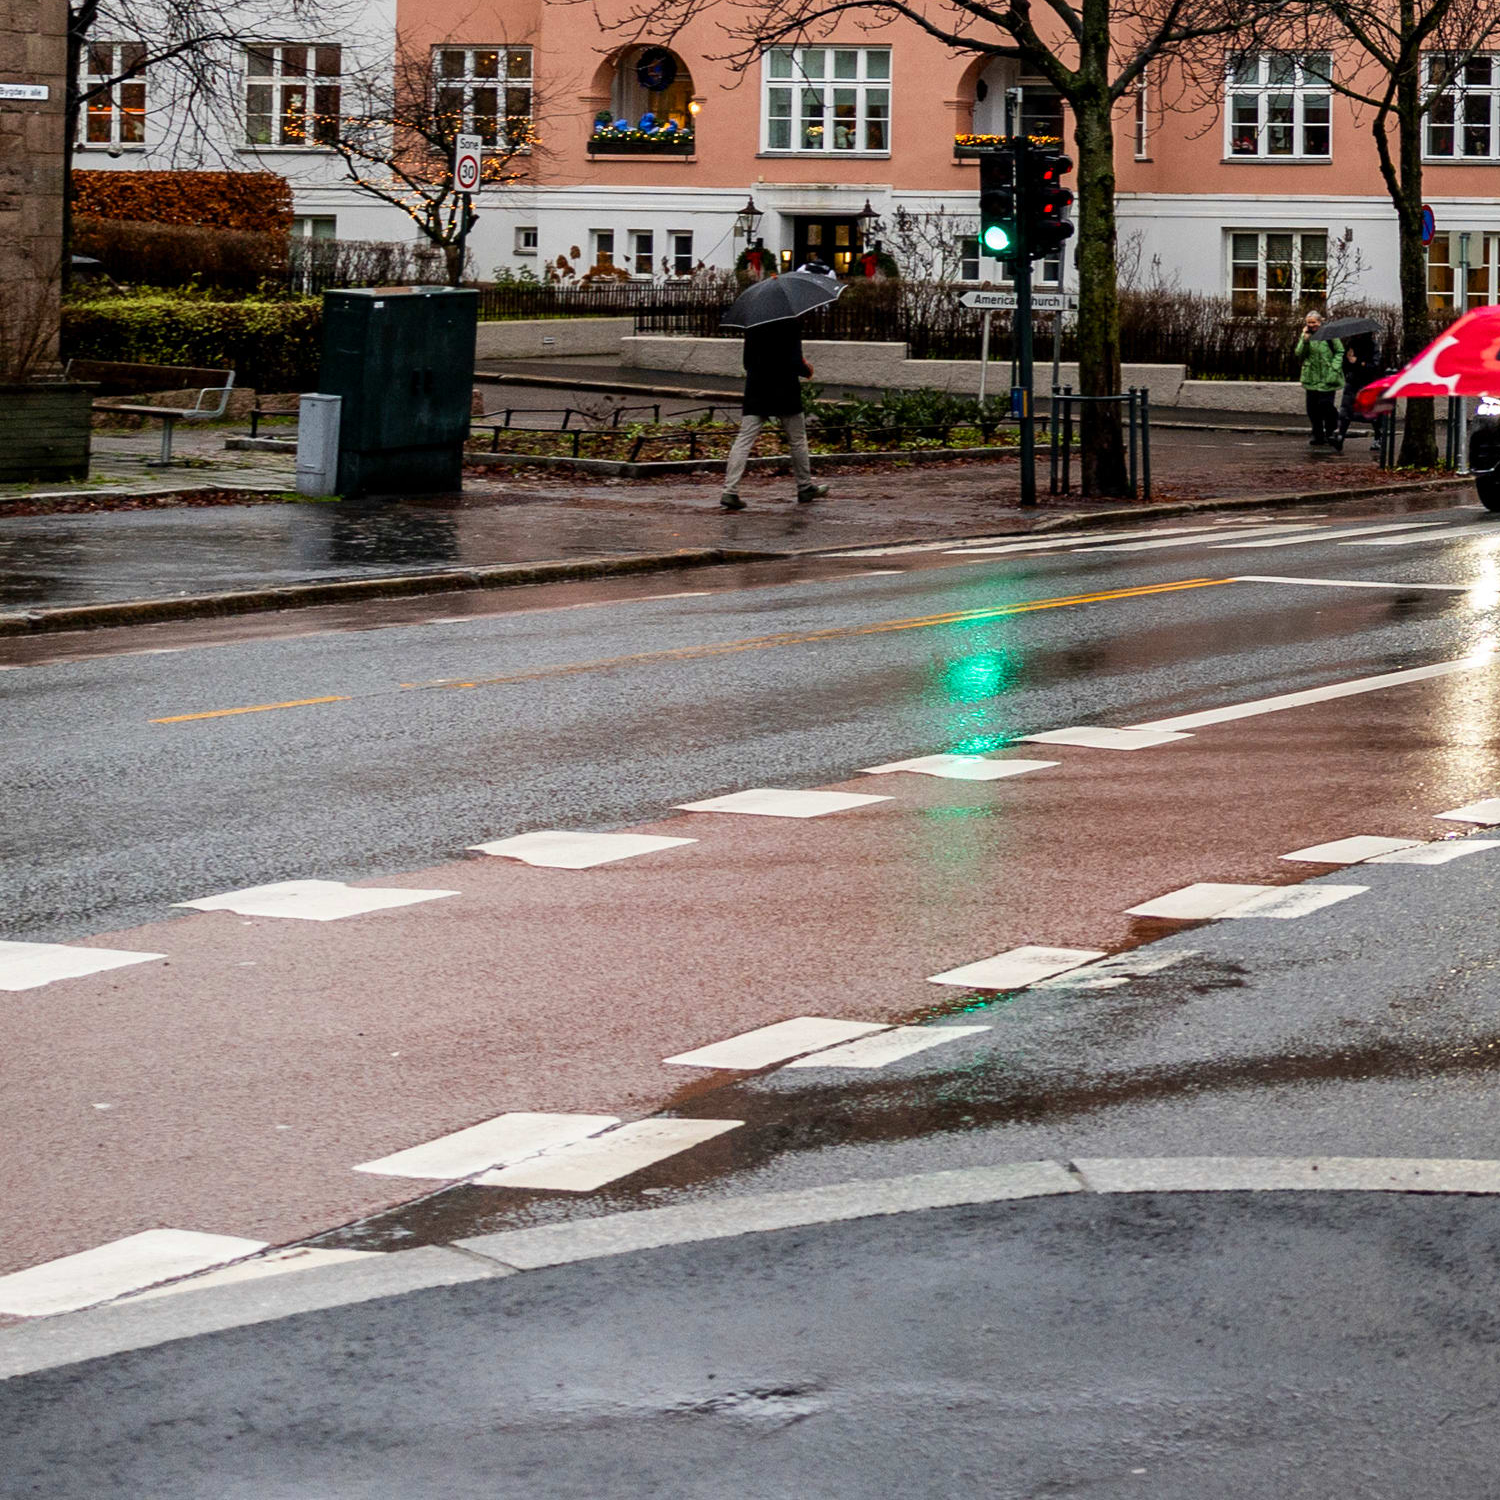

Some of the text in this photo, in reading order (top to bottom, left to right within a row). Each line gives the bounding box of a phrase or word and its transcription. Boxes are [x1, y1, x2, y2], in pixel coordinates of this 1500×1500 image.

[460, 138, 479, 150] Sone
[462, 164, 475, 179] 30
[974, 294, 1060, 307] America hurch
